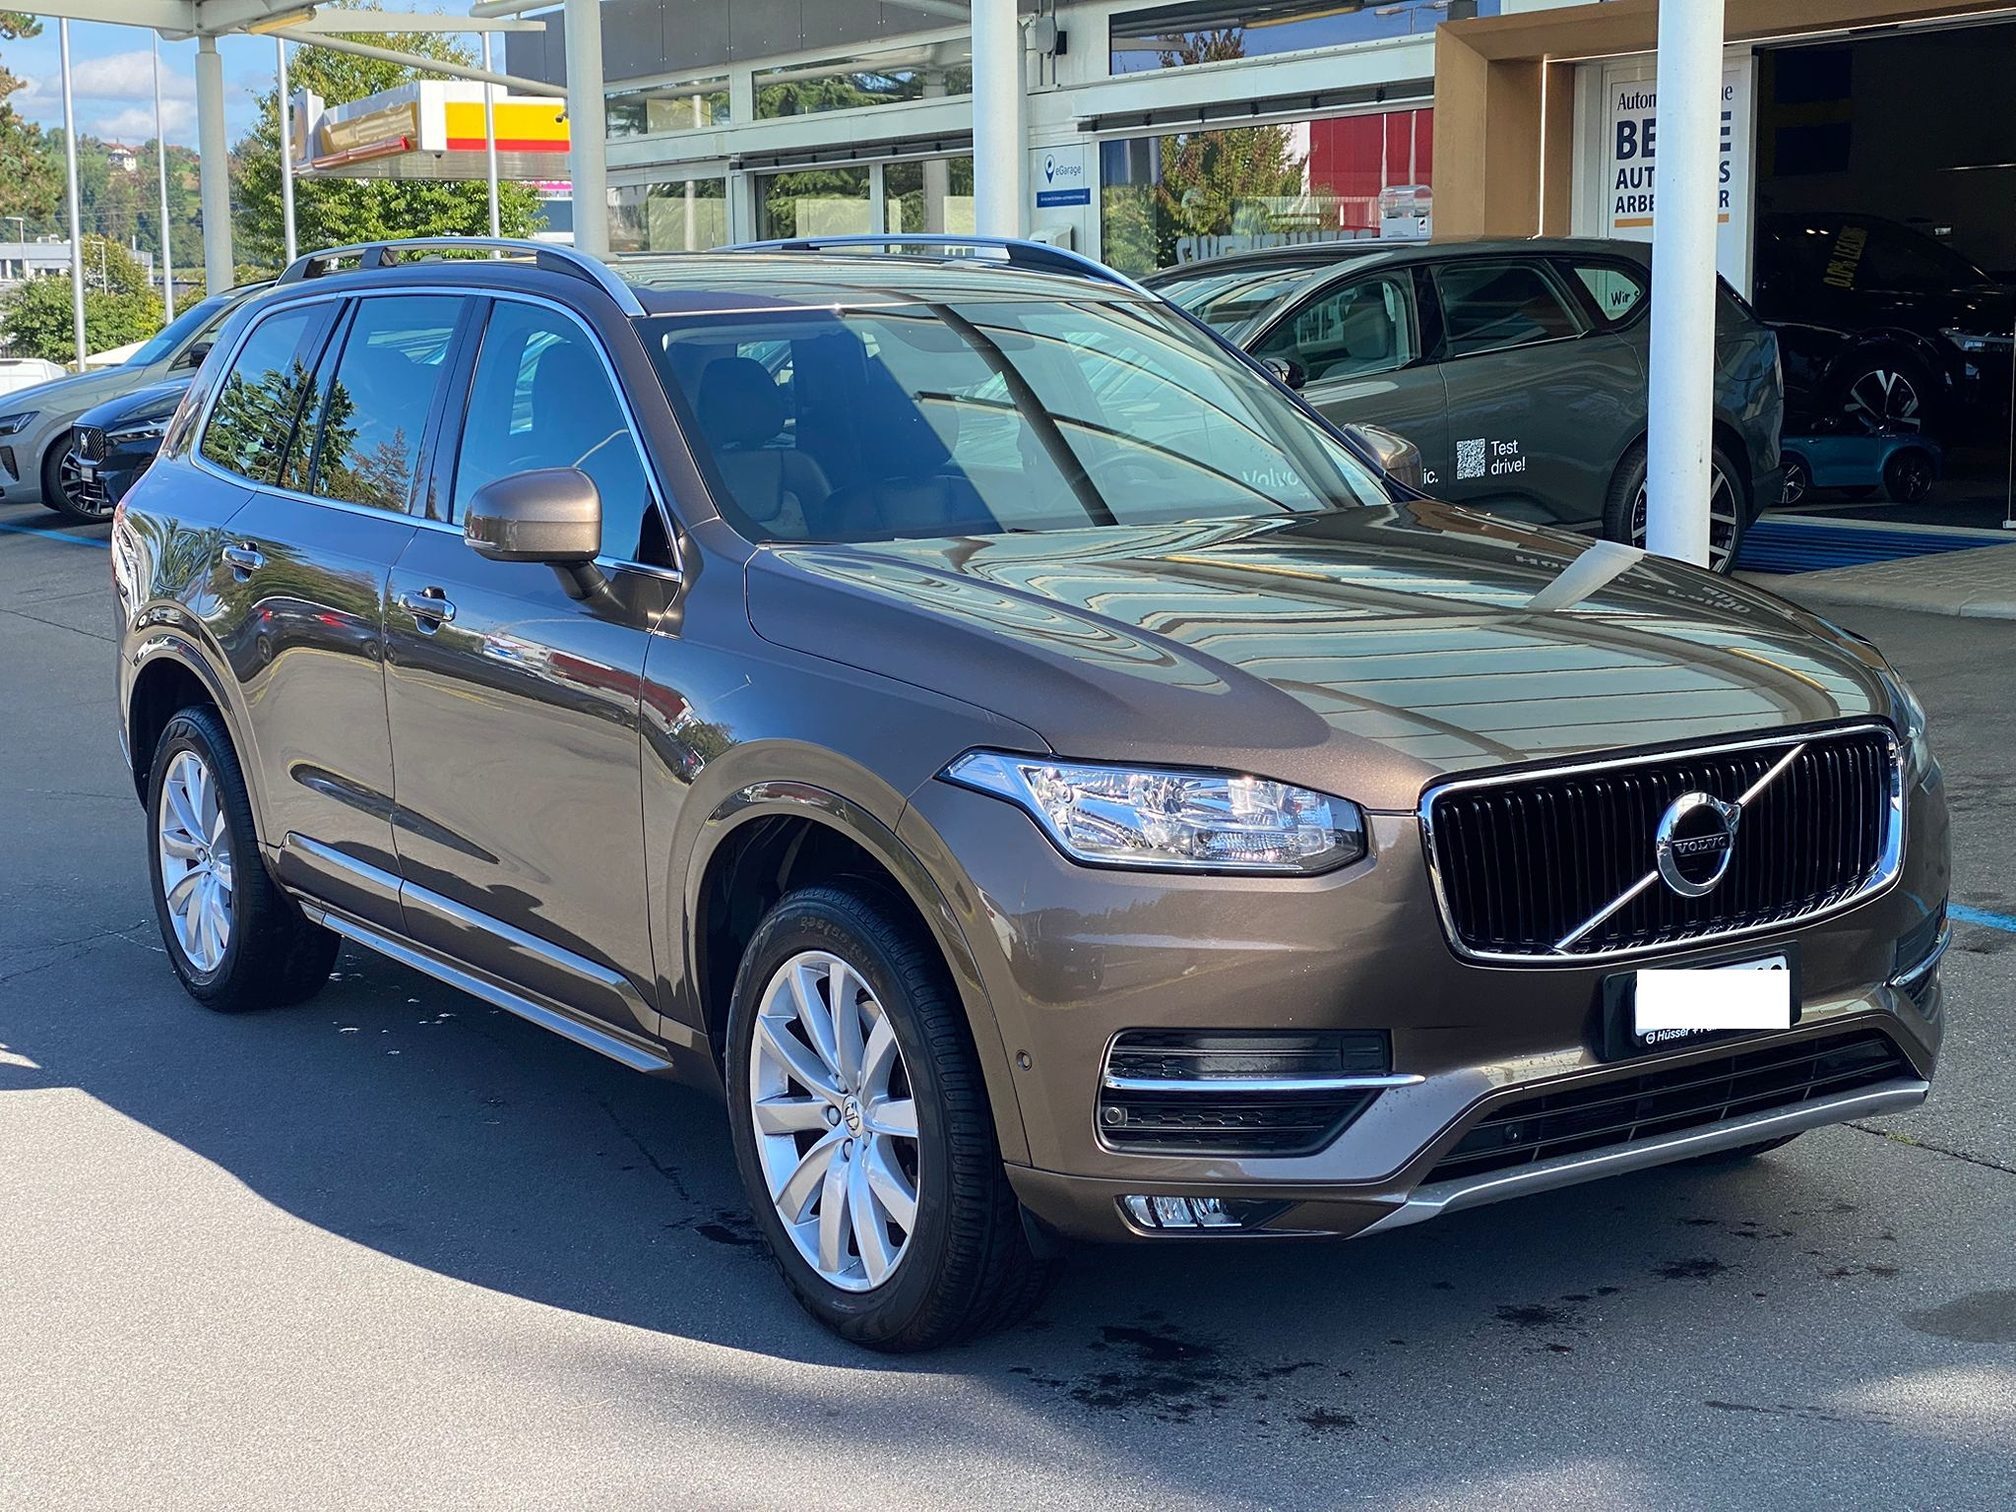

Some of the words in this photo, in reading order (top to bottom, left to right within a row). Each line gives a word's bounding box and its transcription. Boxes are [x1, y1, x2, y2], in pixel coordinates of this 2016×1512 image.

[1610, 290, 1631, 306] Wir
[1490, 440, 1518, 456] Test
[1490, 456, 1526, 475] drive!
[1423, 468, 1439, 484] ic.
[1674, 836, 1726, 854] VOLVO
